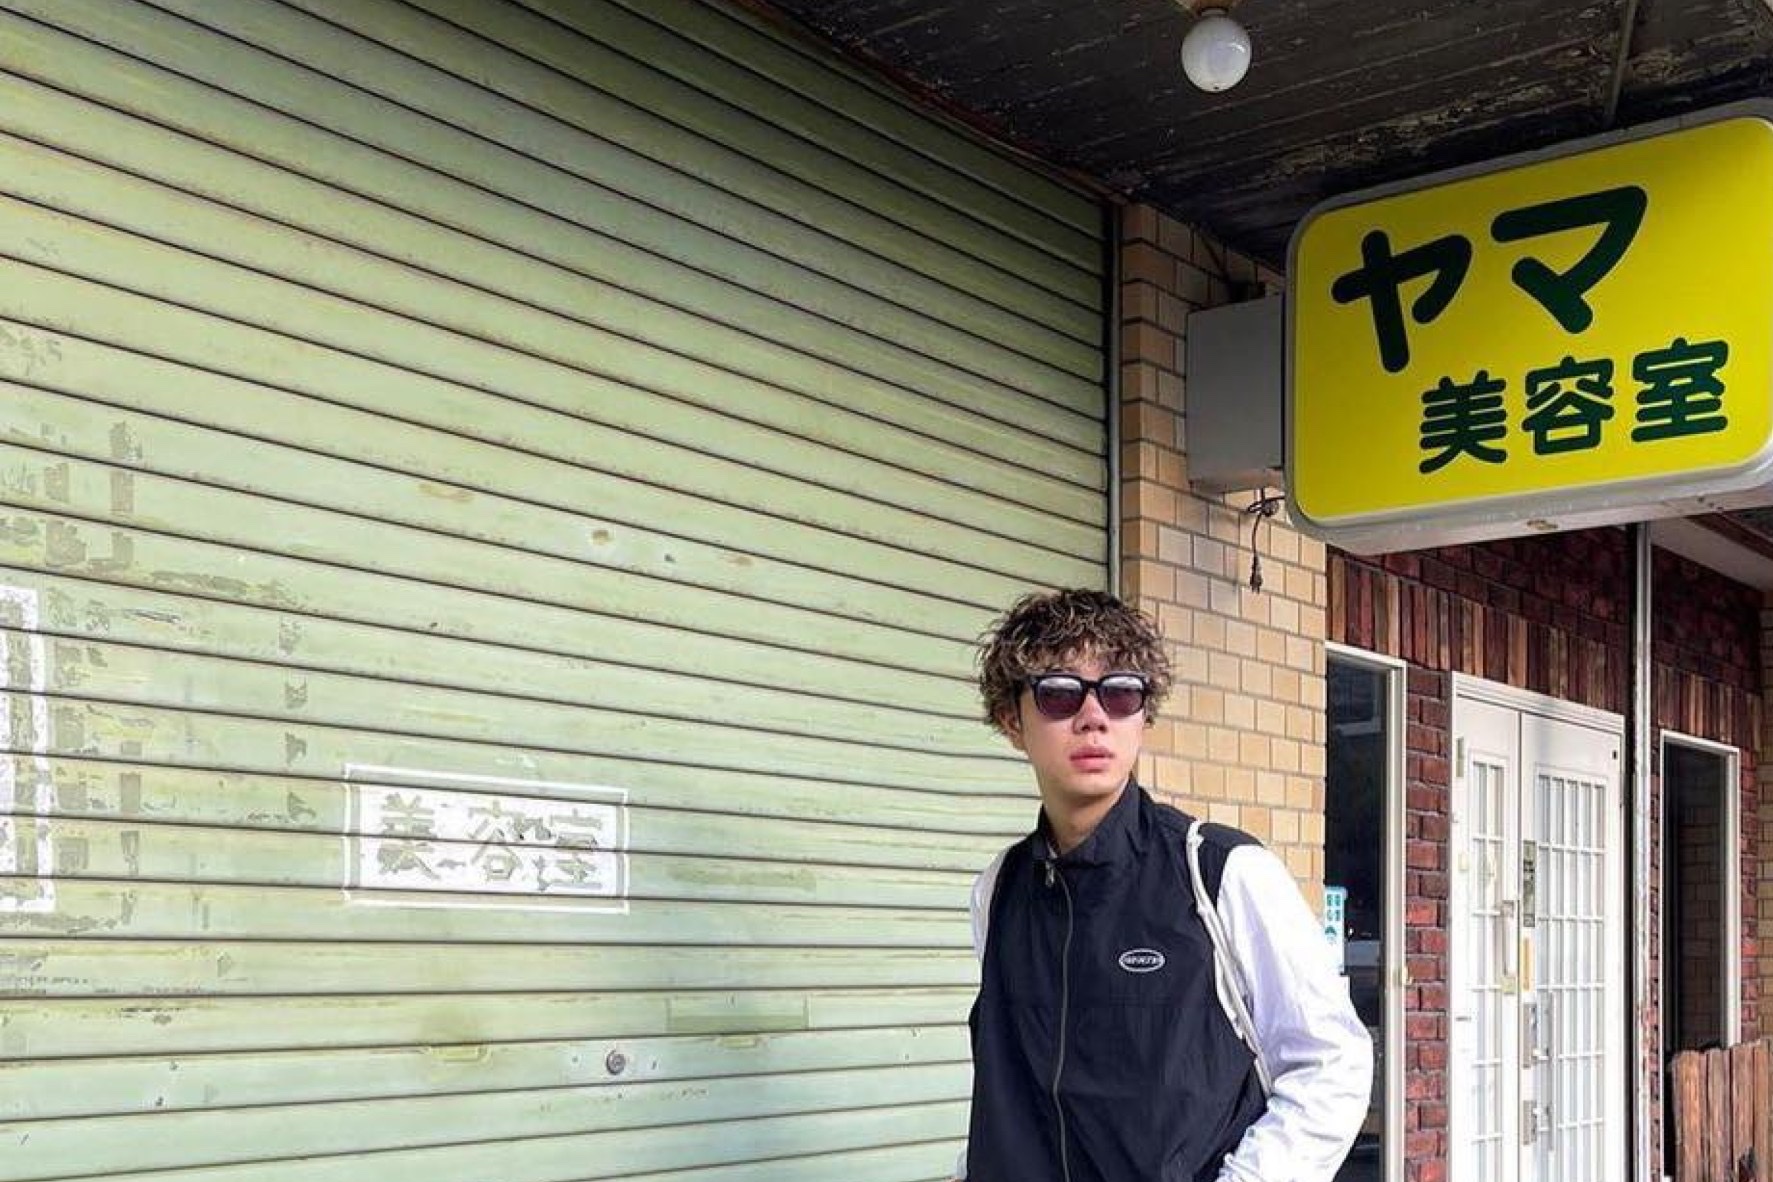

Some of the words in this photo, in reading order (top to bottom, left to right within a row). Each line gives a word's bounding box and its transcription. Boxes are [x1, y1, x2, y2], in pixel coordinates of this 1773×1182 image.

[1332, 186, 1648, 372] ヤマ
[1419, 337, 1729, 473] 美容室
